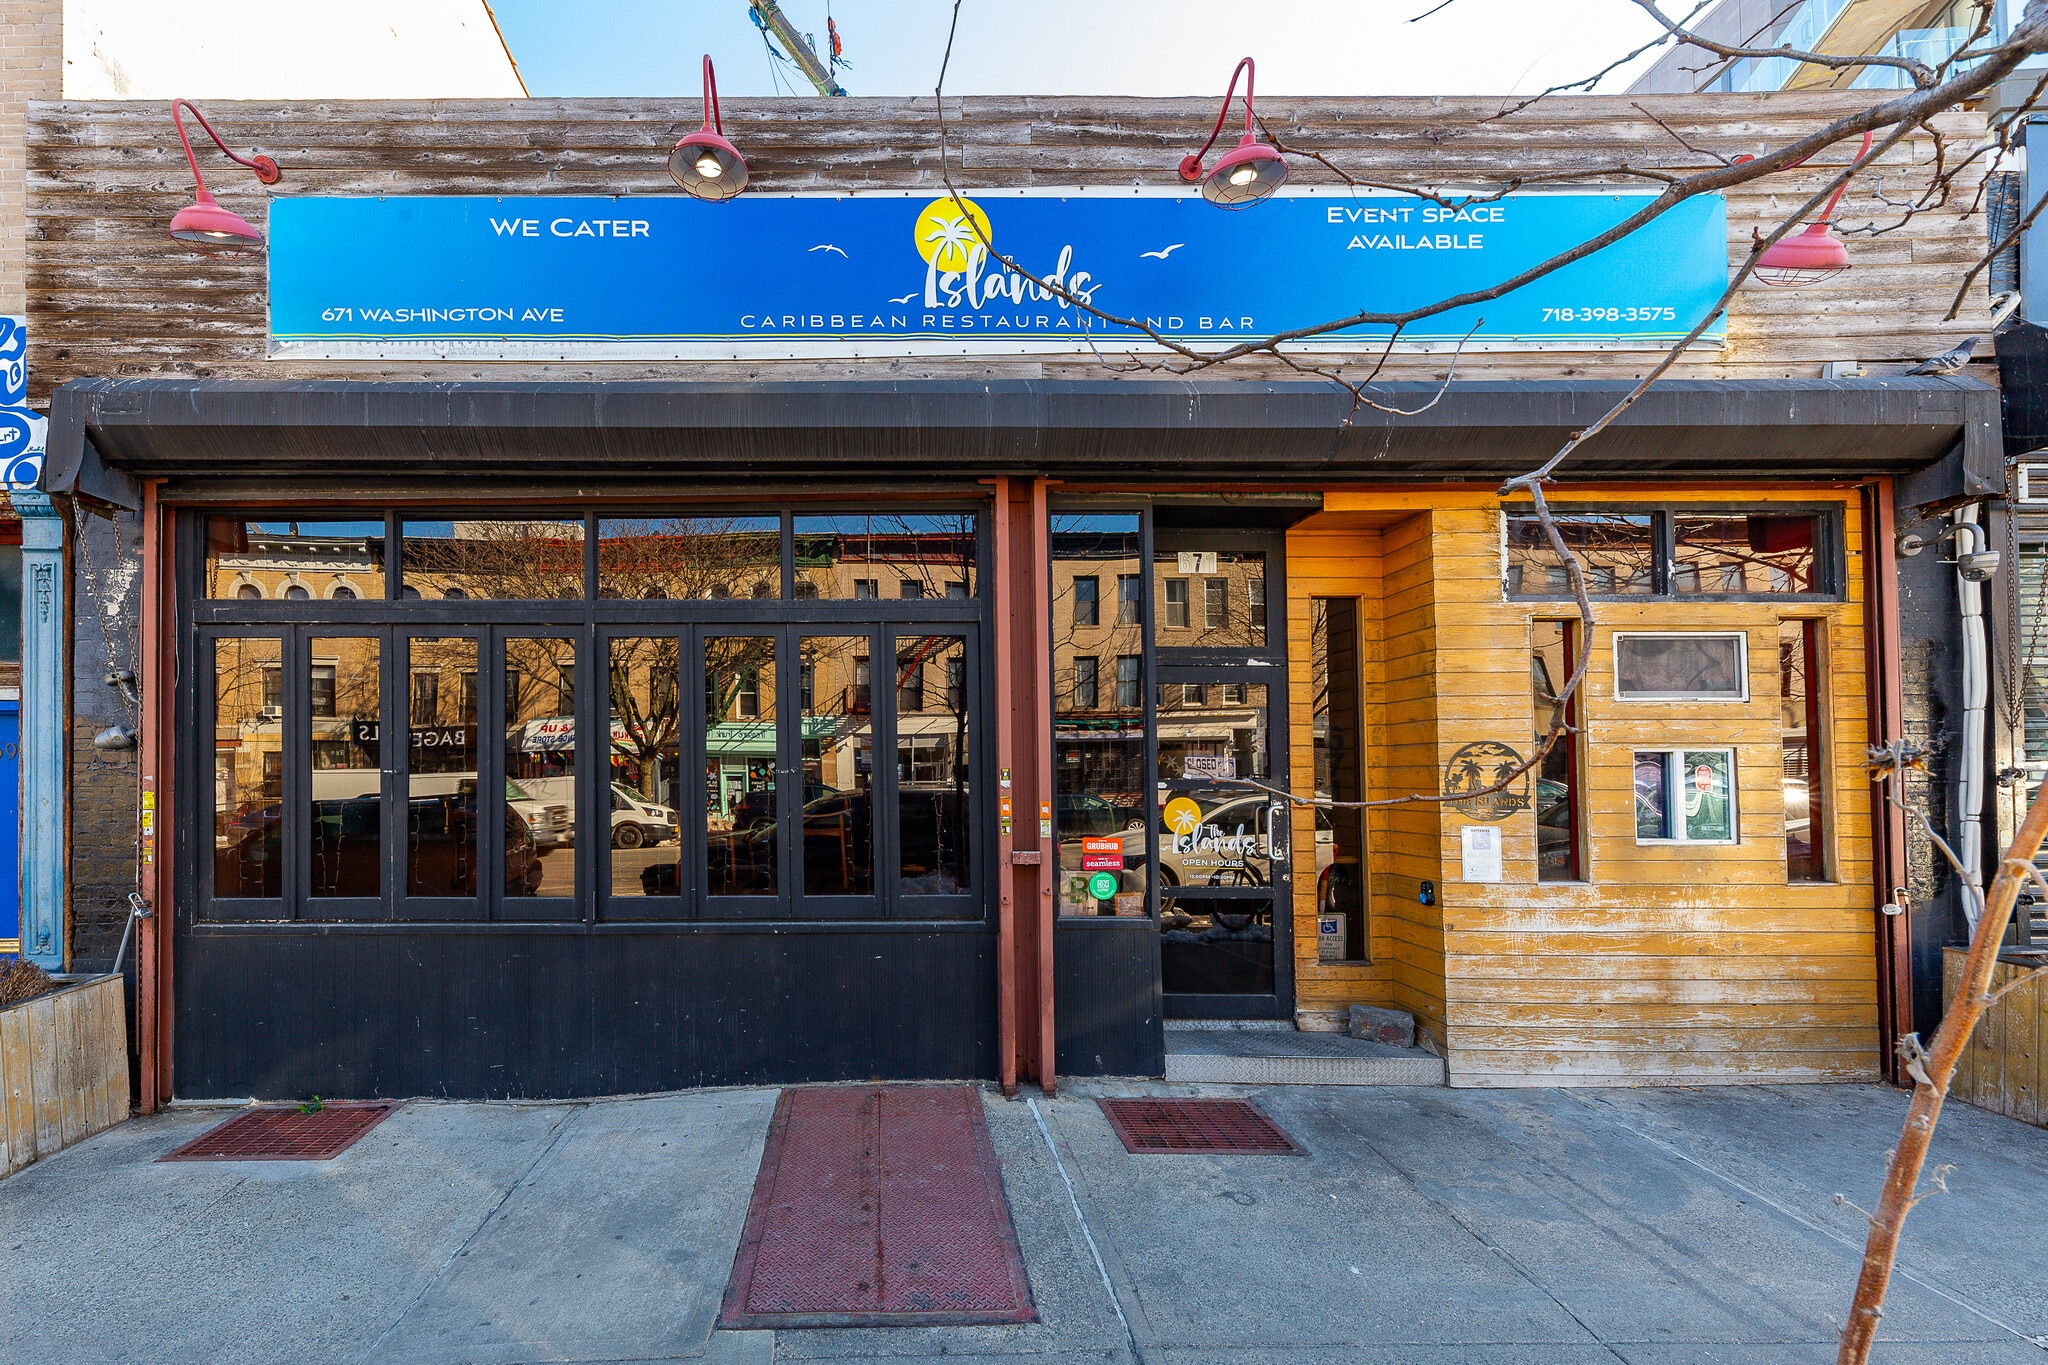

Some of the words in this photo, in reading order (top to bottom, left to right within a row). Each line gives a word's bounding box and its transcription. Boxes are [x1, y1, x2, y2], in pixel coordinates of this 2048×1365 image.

[1327, 206, 1414, 223] EVENT
[1422, 207, 1505, 223] SPACE
[489, 218, 540, 237] WE
[550, 218, 650, 237] CATER
[1346, 234, 1484, 250] AVAILABLE
[924, 241, 1103, 311] Islands
[321, 307, 353, 322] 671
[359, 307, 514, 322] WASHINGTON
[520, 307, 564, 322] AVE
[740, 314, 907, 329] CARIBBEAN
[922, 314, 1111, 329] RESTAURANT
[1199, 316, 1254, 330] BAR
[1541, 307, 1676, 323] 718-398-3575
[0, 742, 17, 760] 9
[1474, 796, 1525, 807] ISLANDS
[1172, 822, 1260, 856] Islands
[1207, 824, 1225, 838] The
[1086, 842, 1119, 851] GRUBHUB
[1086, 860, 1121, 868] seamless
[1182, 859, 1208, 867] OPEN
[1210, 860, 1244, 868] HOURS
